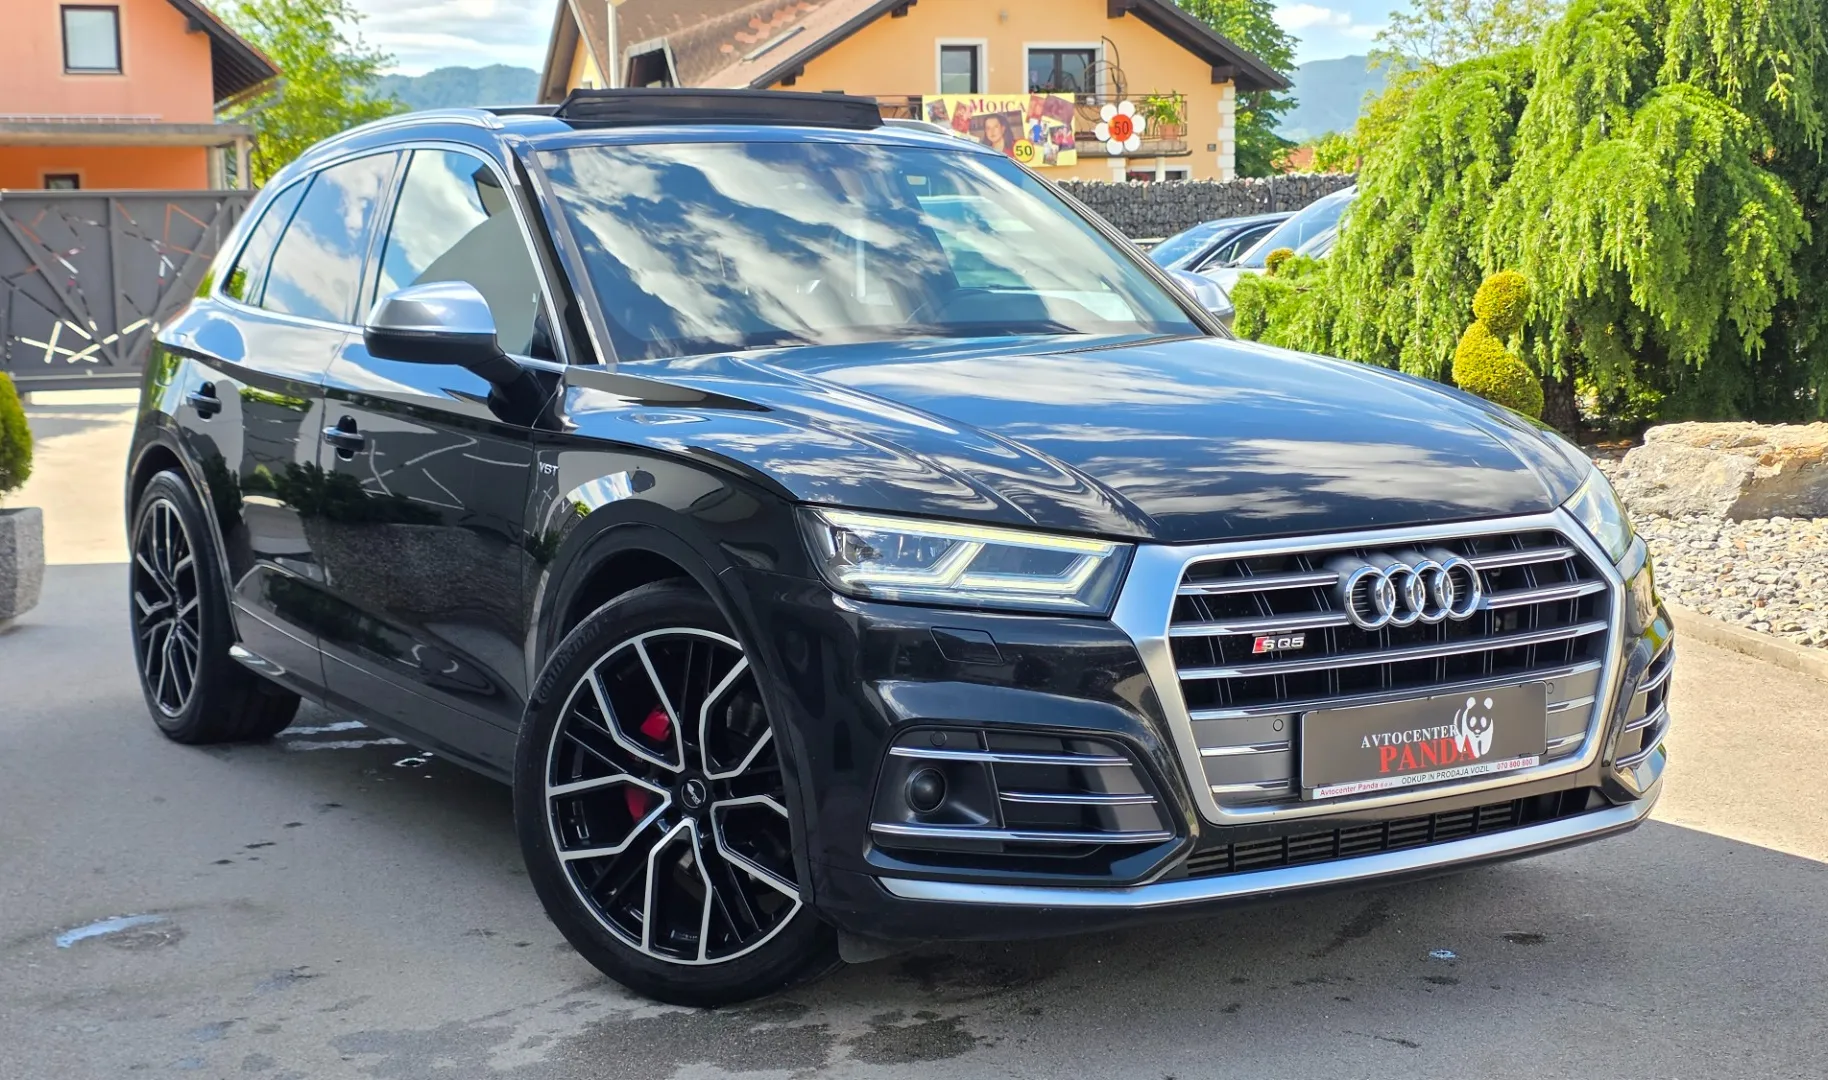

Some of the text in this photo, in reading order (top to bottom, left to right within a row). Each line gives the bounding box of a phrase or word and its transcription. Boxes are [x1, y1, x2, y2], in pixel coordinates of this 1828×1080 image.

[1114, 120, 1130, 135] 50
[1015, 145, 1033, 157] 50
[1258, 636, 1305, 652] SQ5
[1361, 724, 1459, 749] AVTOCENTER
[1378, 734, 1477, 773] PANDA
[1401, 765, 1490, 785] ODKUP IN PRODAJA VOZIL
[1320, 785, 1356, 796] Avtocenter
[1358, 782, 1379, 791] Panda
